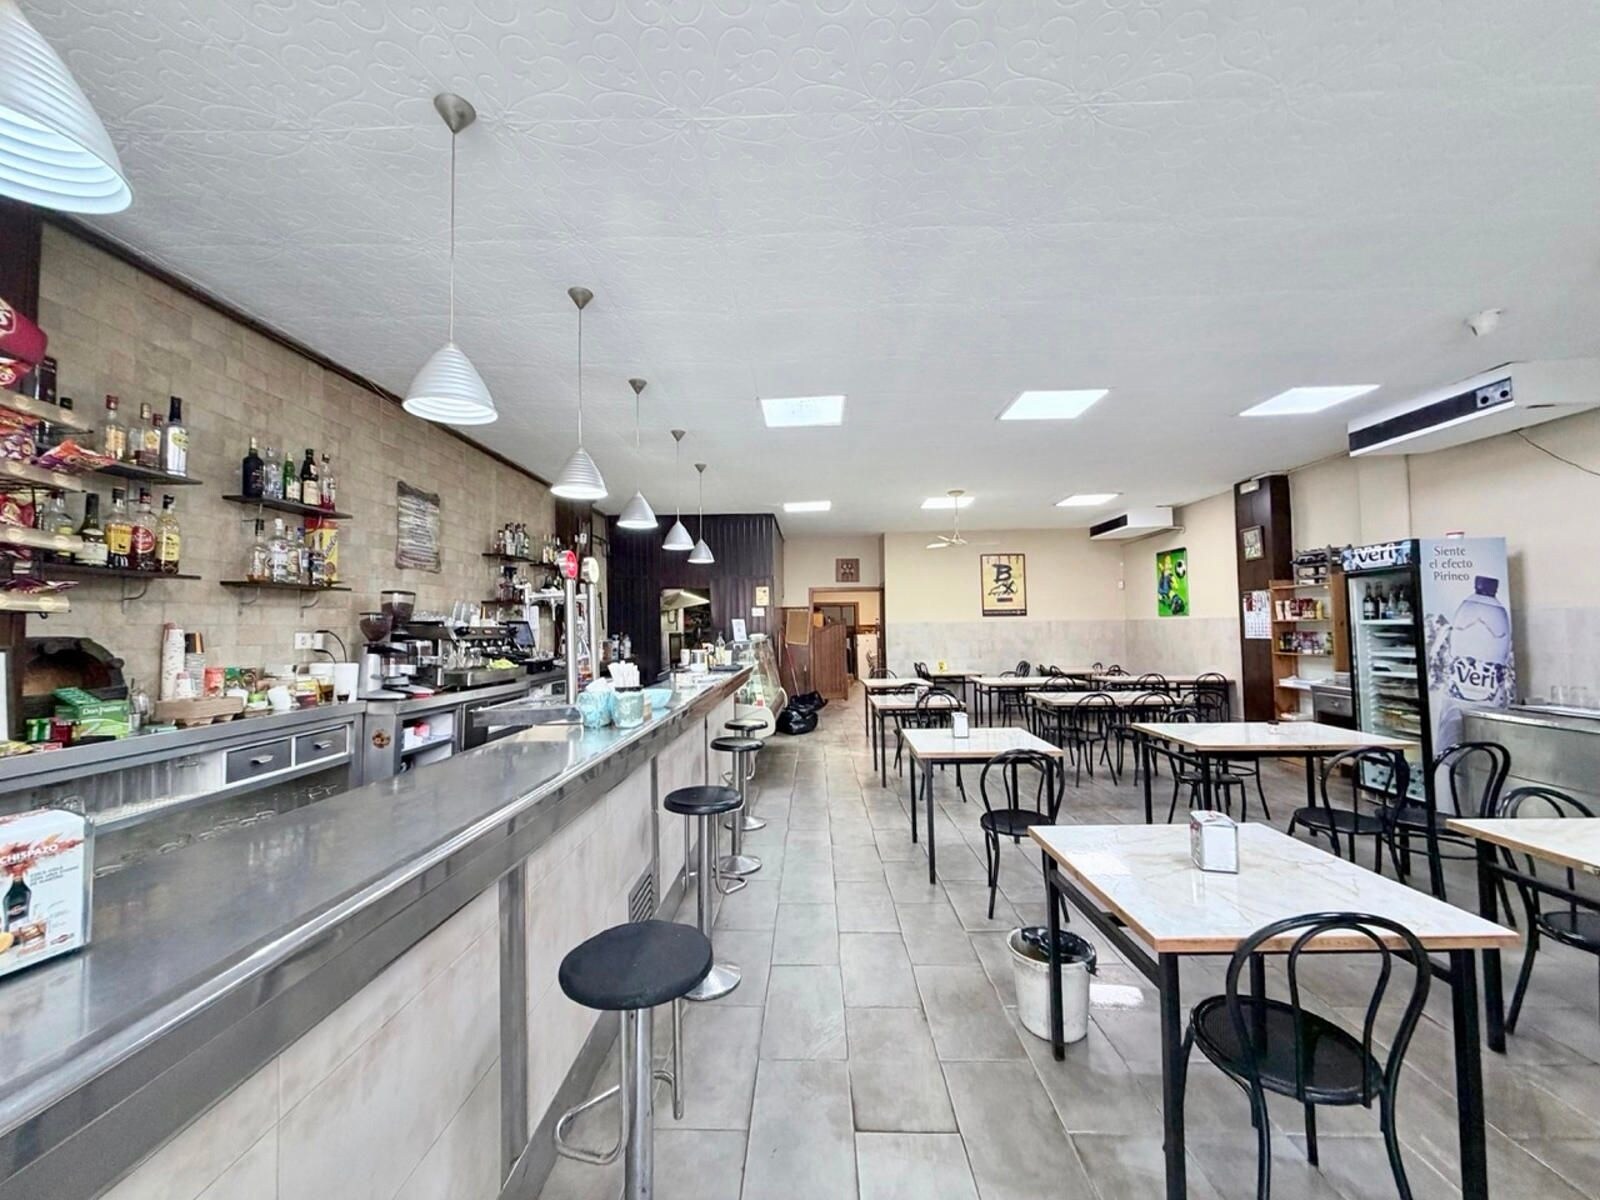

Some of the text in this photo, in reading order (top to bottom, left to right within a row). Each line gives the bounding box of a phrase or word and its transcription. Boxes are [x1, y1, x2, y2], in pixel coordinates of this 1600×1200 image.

[1433, 545, 1467, 557] Siente
[1429, 558, 1473, 569] el efecto
[1433, 571, 1470, 581] Pirineo
[1456, 665, 1496, 689] Veri
